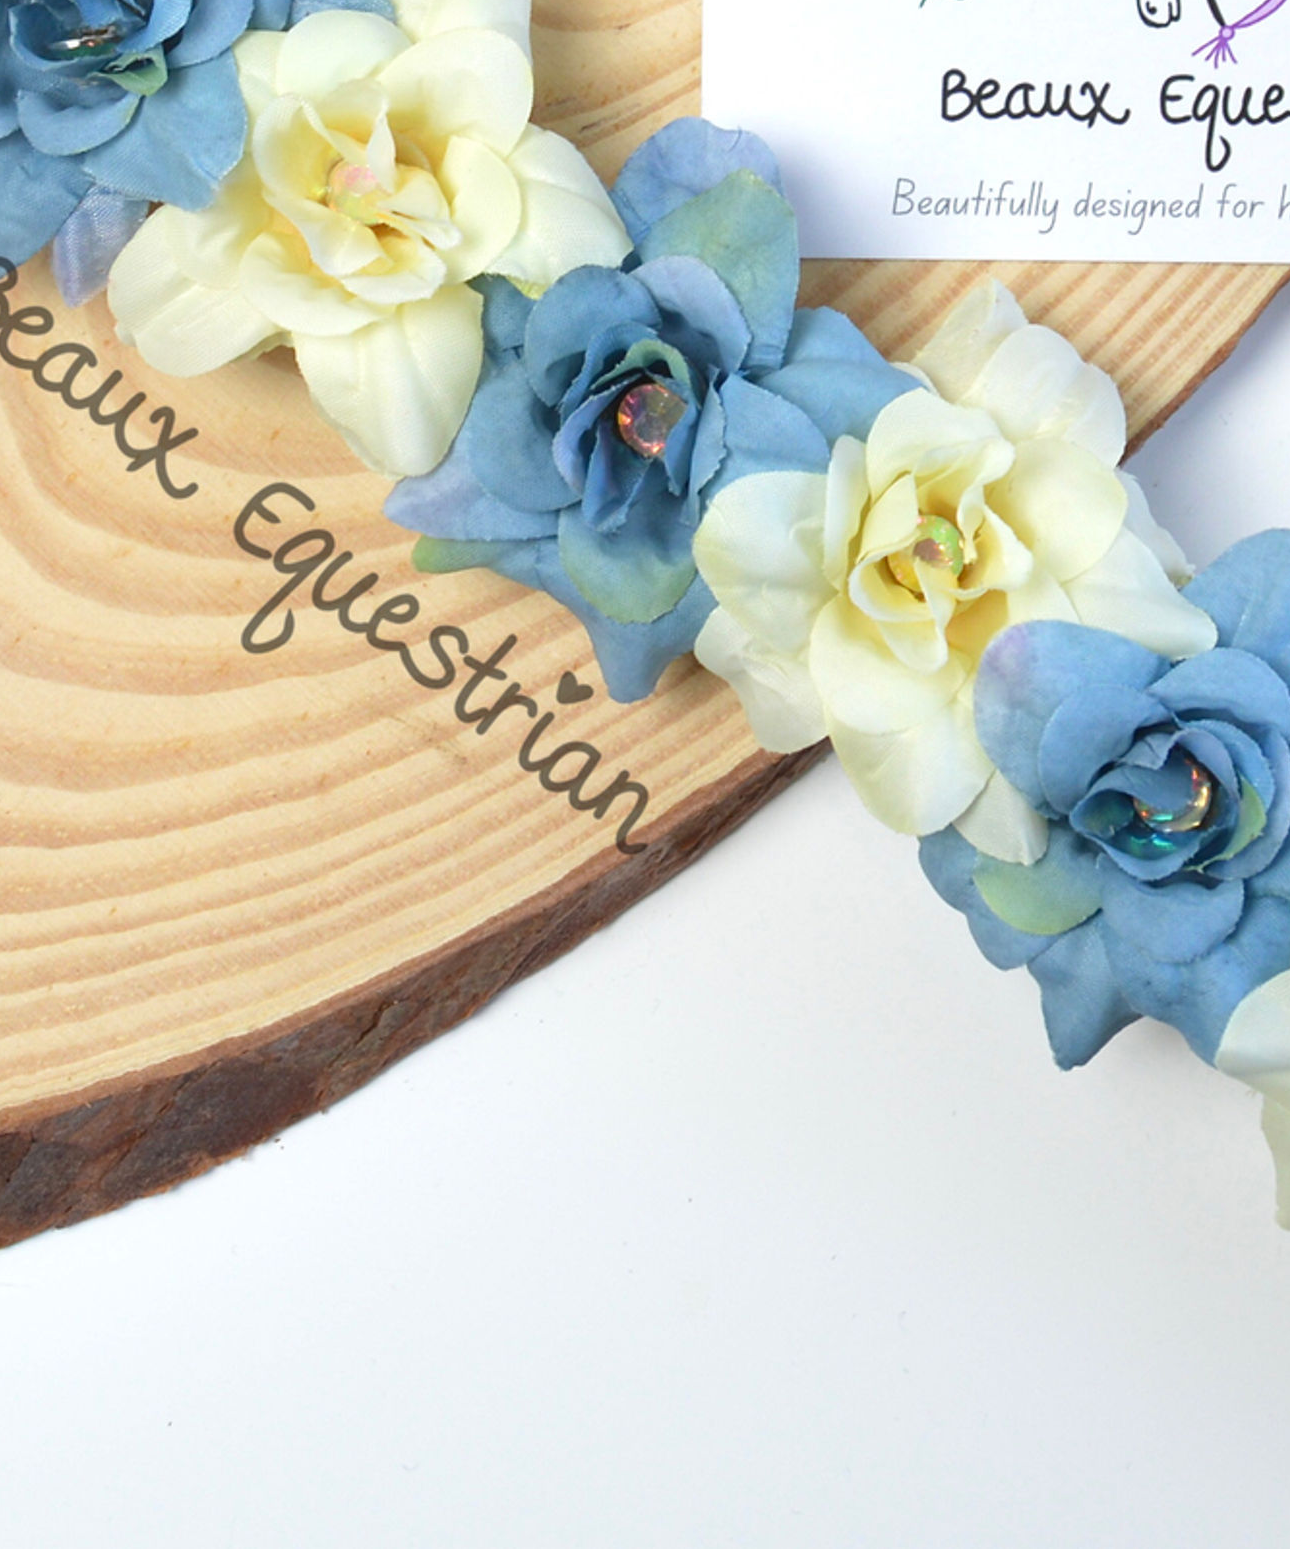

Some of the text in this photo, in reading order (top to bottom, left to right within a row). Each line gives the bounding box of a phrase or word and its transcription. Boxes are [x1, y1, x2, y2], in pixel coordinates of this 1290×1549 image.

[940, 68, 1131, 128] Beaux
[891, 178, 1060, 235] Beautifully
[1073, 182, 1203, 236] designed
[1216, 184, 1265, 220] for
